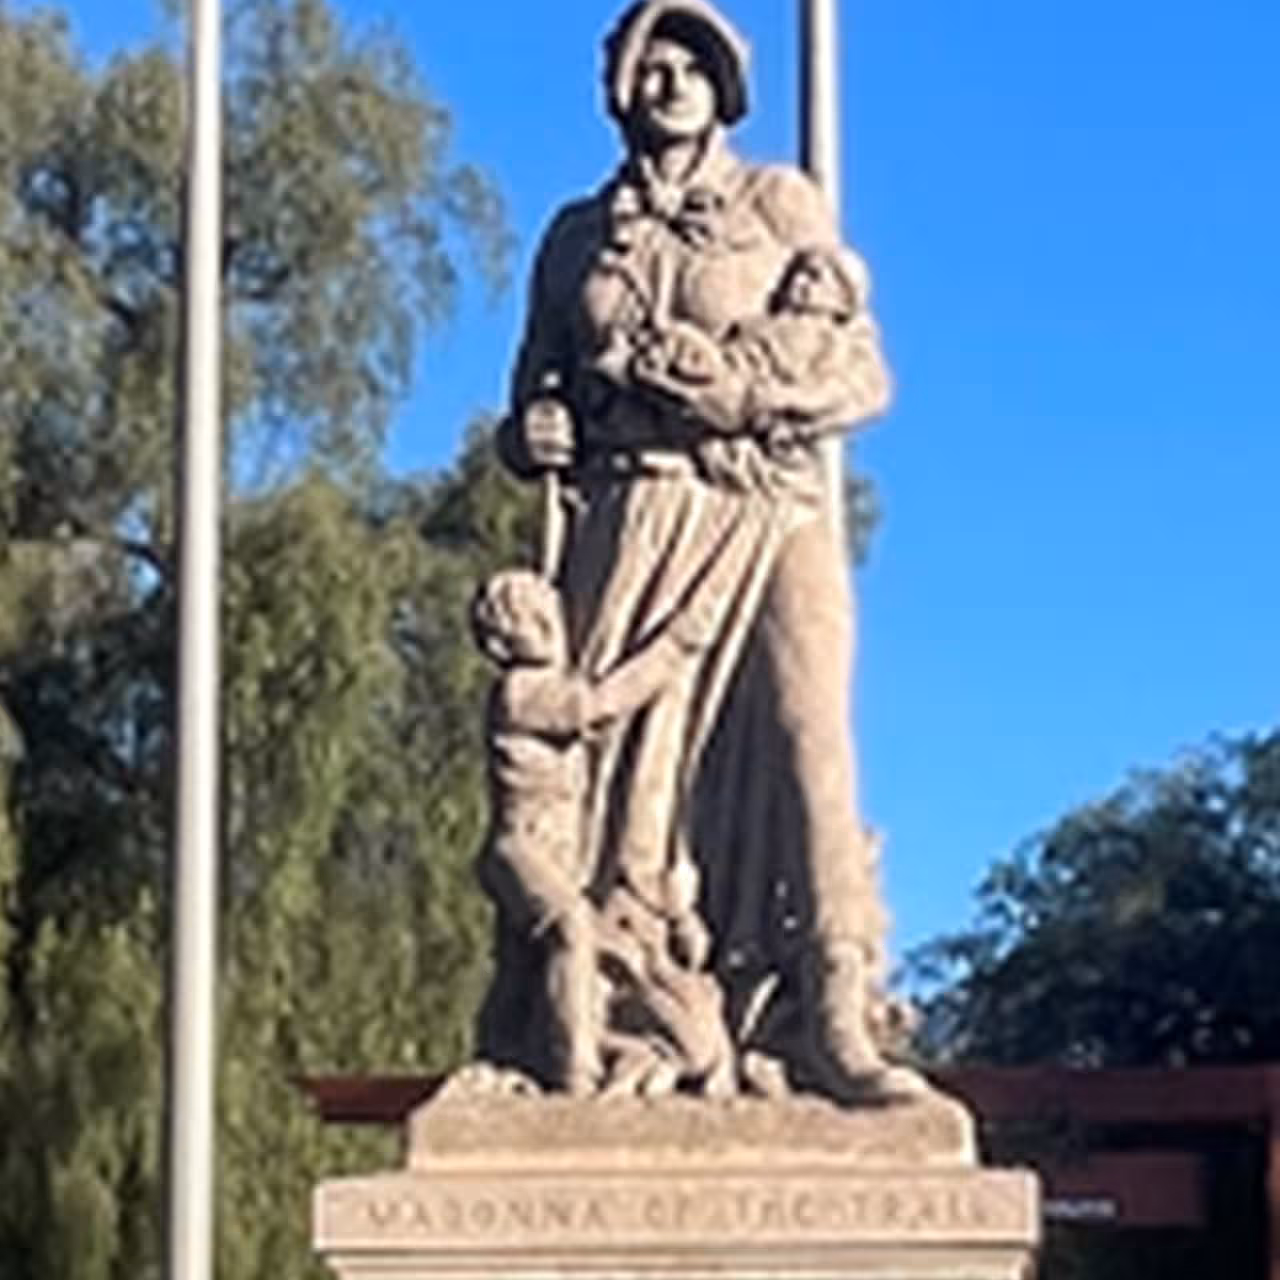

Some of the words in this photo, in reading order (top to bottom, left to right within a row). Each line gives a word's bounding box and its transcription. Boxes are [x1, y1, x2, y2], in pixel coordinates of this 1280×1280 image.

[367, 1196, 607, 1230] MADONNA
[643, 1194, 692, 1230] OF
[730, 1192, 816, 1230] THE
[849, 1190, 988, 1230] TRAIL
